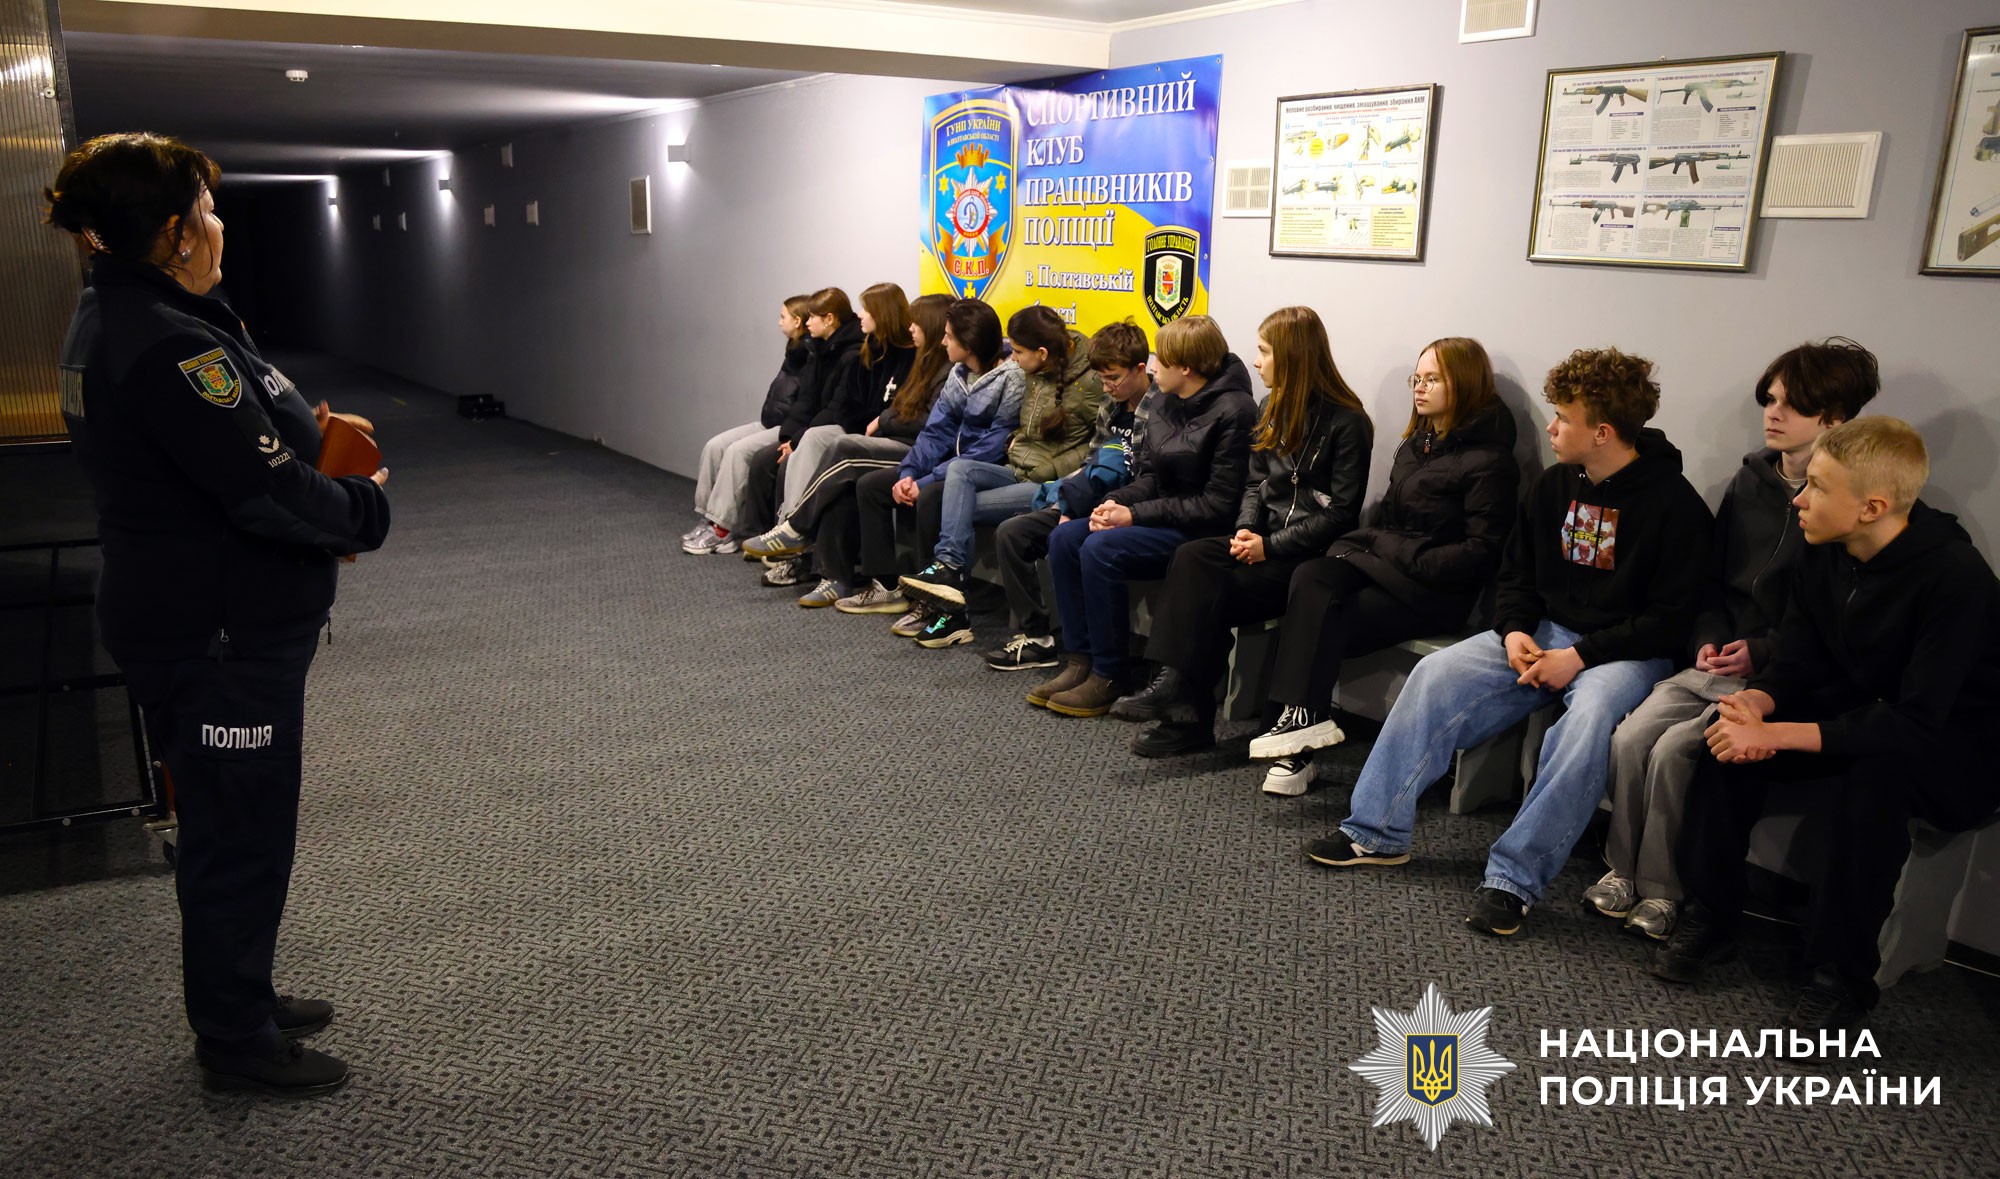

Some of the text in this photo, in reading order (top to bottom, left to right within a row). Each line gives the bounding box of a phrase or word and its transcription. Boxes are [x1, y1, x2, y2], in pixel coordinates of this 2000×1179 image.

[1026, 71, 1197, 127] СПОРТИВНИЙ
[968, 116, 1001, 132] УКРАЇНИ
[1026, 135, 1084, 166] КЛУБ
[1024, 171, 1193, 210] ПРАЦІВНИКІВ
[1024, 209, 1115, 251] ПОЛІЦІЇ
[954, 258, 990, 276] С.К.П.
[1025, 265, 1134, 292] в Полтавській
[202, 724, 272, 750] ПОЛІЦІЯ
